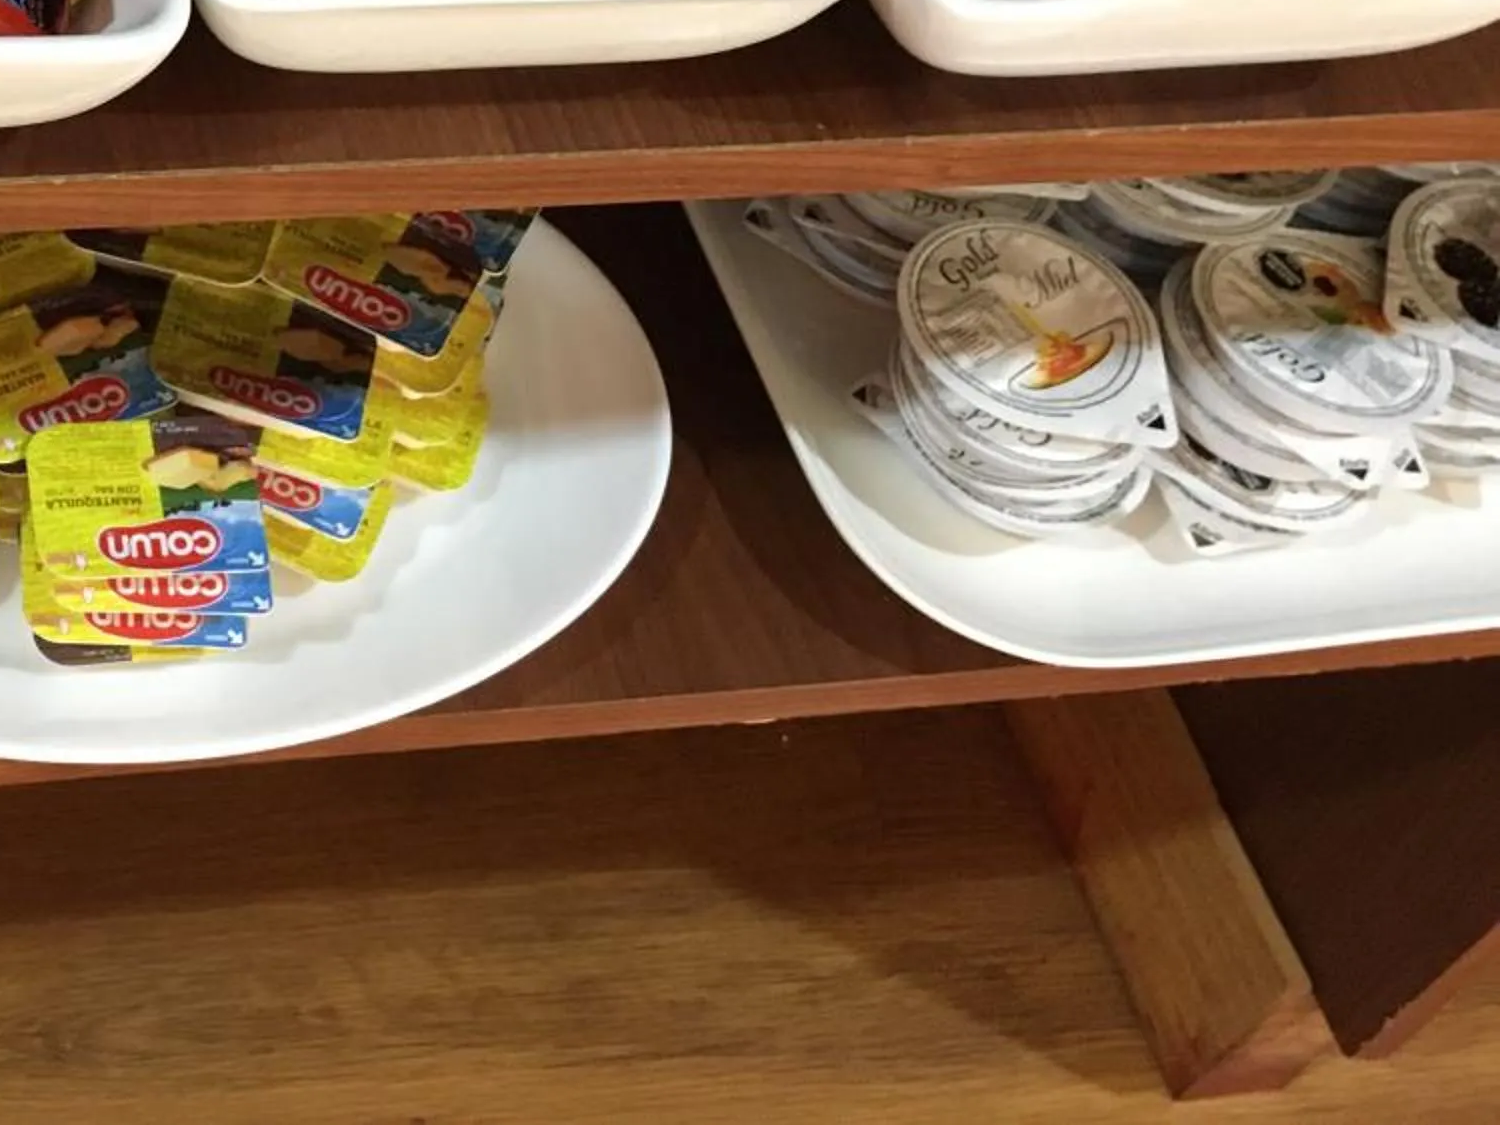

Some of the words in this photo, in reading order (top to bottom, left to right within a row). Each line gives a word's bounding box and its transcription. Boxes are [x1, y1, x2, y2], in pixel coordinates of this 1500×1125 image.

[939, 227, 1000, 292] Gold
[1018, 256, 1080, 309] Miel
[309, 268, 404, 326] COLUN
[24, 384, 126, 432] COLUN
[214, 368, 317, 415] COLUN
[105, 528, 218, 560] COLUN
